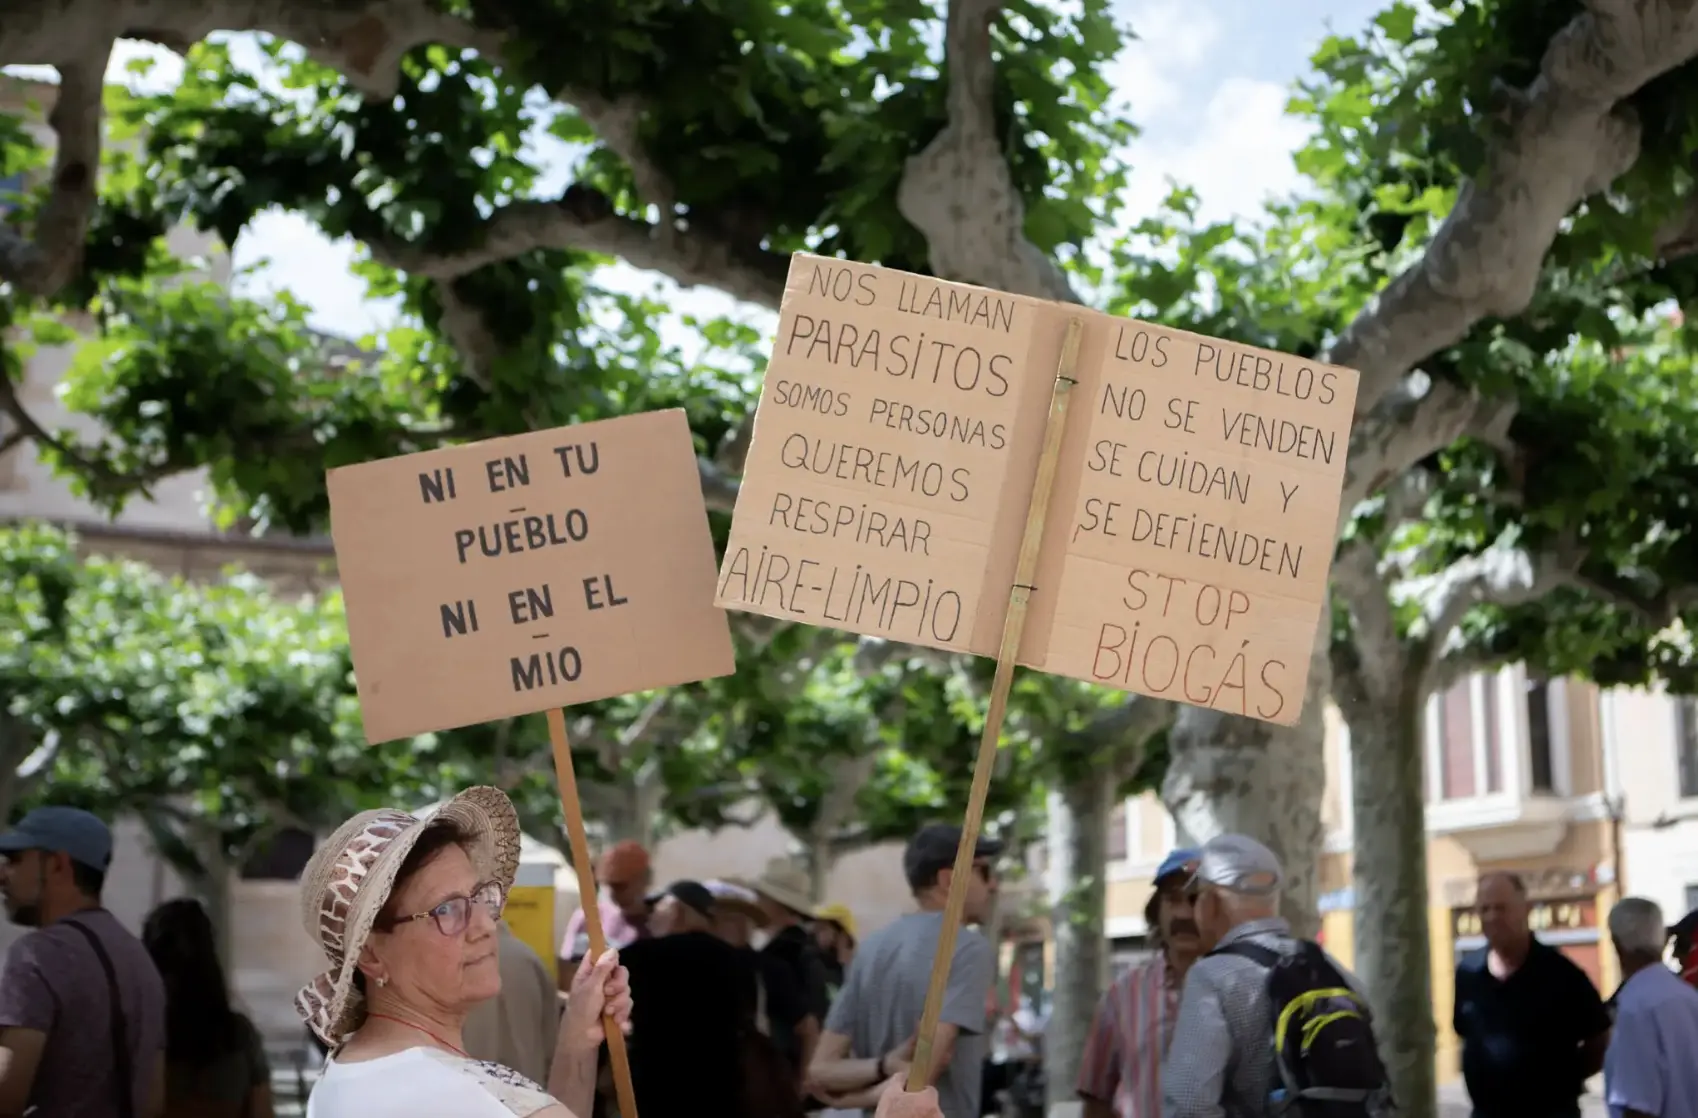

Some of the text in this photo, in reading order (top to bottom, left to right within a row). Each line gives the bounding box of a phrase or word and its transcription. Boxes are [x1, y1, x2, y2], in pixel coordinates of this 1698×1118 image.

[808, 264, 1015, 333] NOS LLAMAN
[1115, 326, 1338, 405] LOS PUEBLOS
[773, 380, 1005, 450] SOMOS PERSONAS
[1100, 383, 1335, 464] NO SE VENDEN
[419, 442, 599, 503] NI EN TU
[781, 433, 970, 502] QUEREMOS
[1087, 439, 1128, 477] SE
[1279, 481, 1299, 513] Y
[455, 509, 589, 563] PUEBLO
[1079, 498, 1122, 536] SE
[440, 574, 628, 638] NI EN EL
[1123, 569, 1250, 630] STOP
[510, 646, 582, 692] MIO
